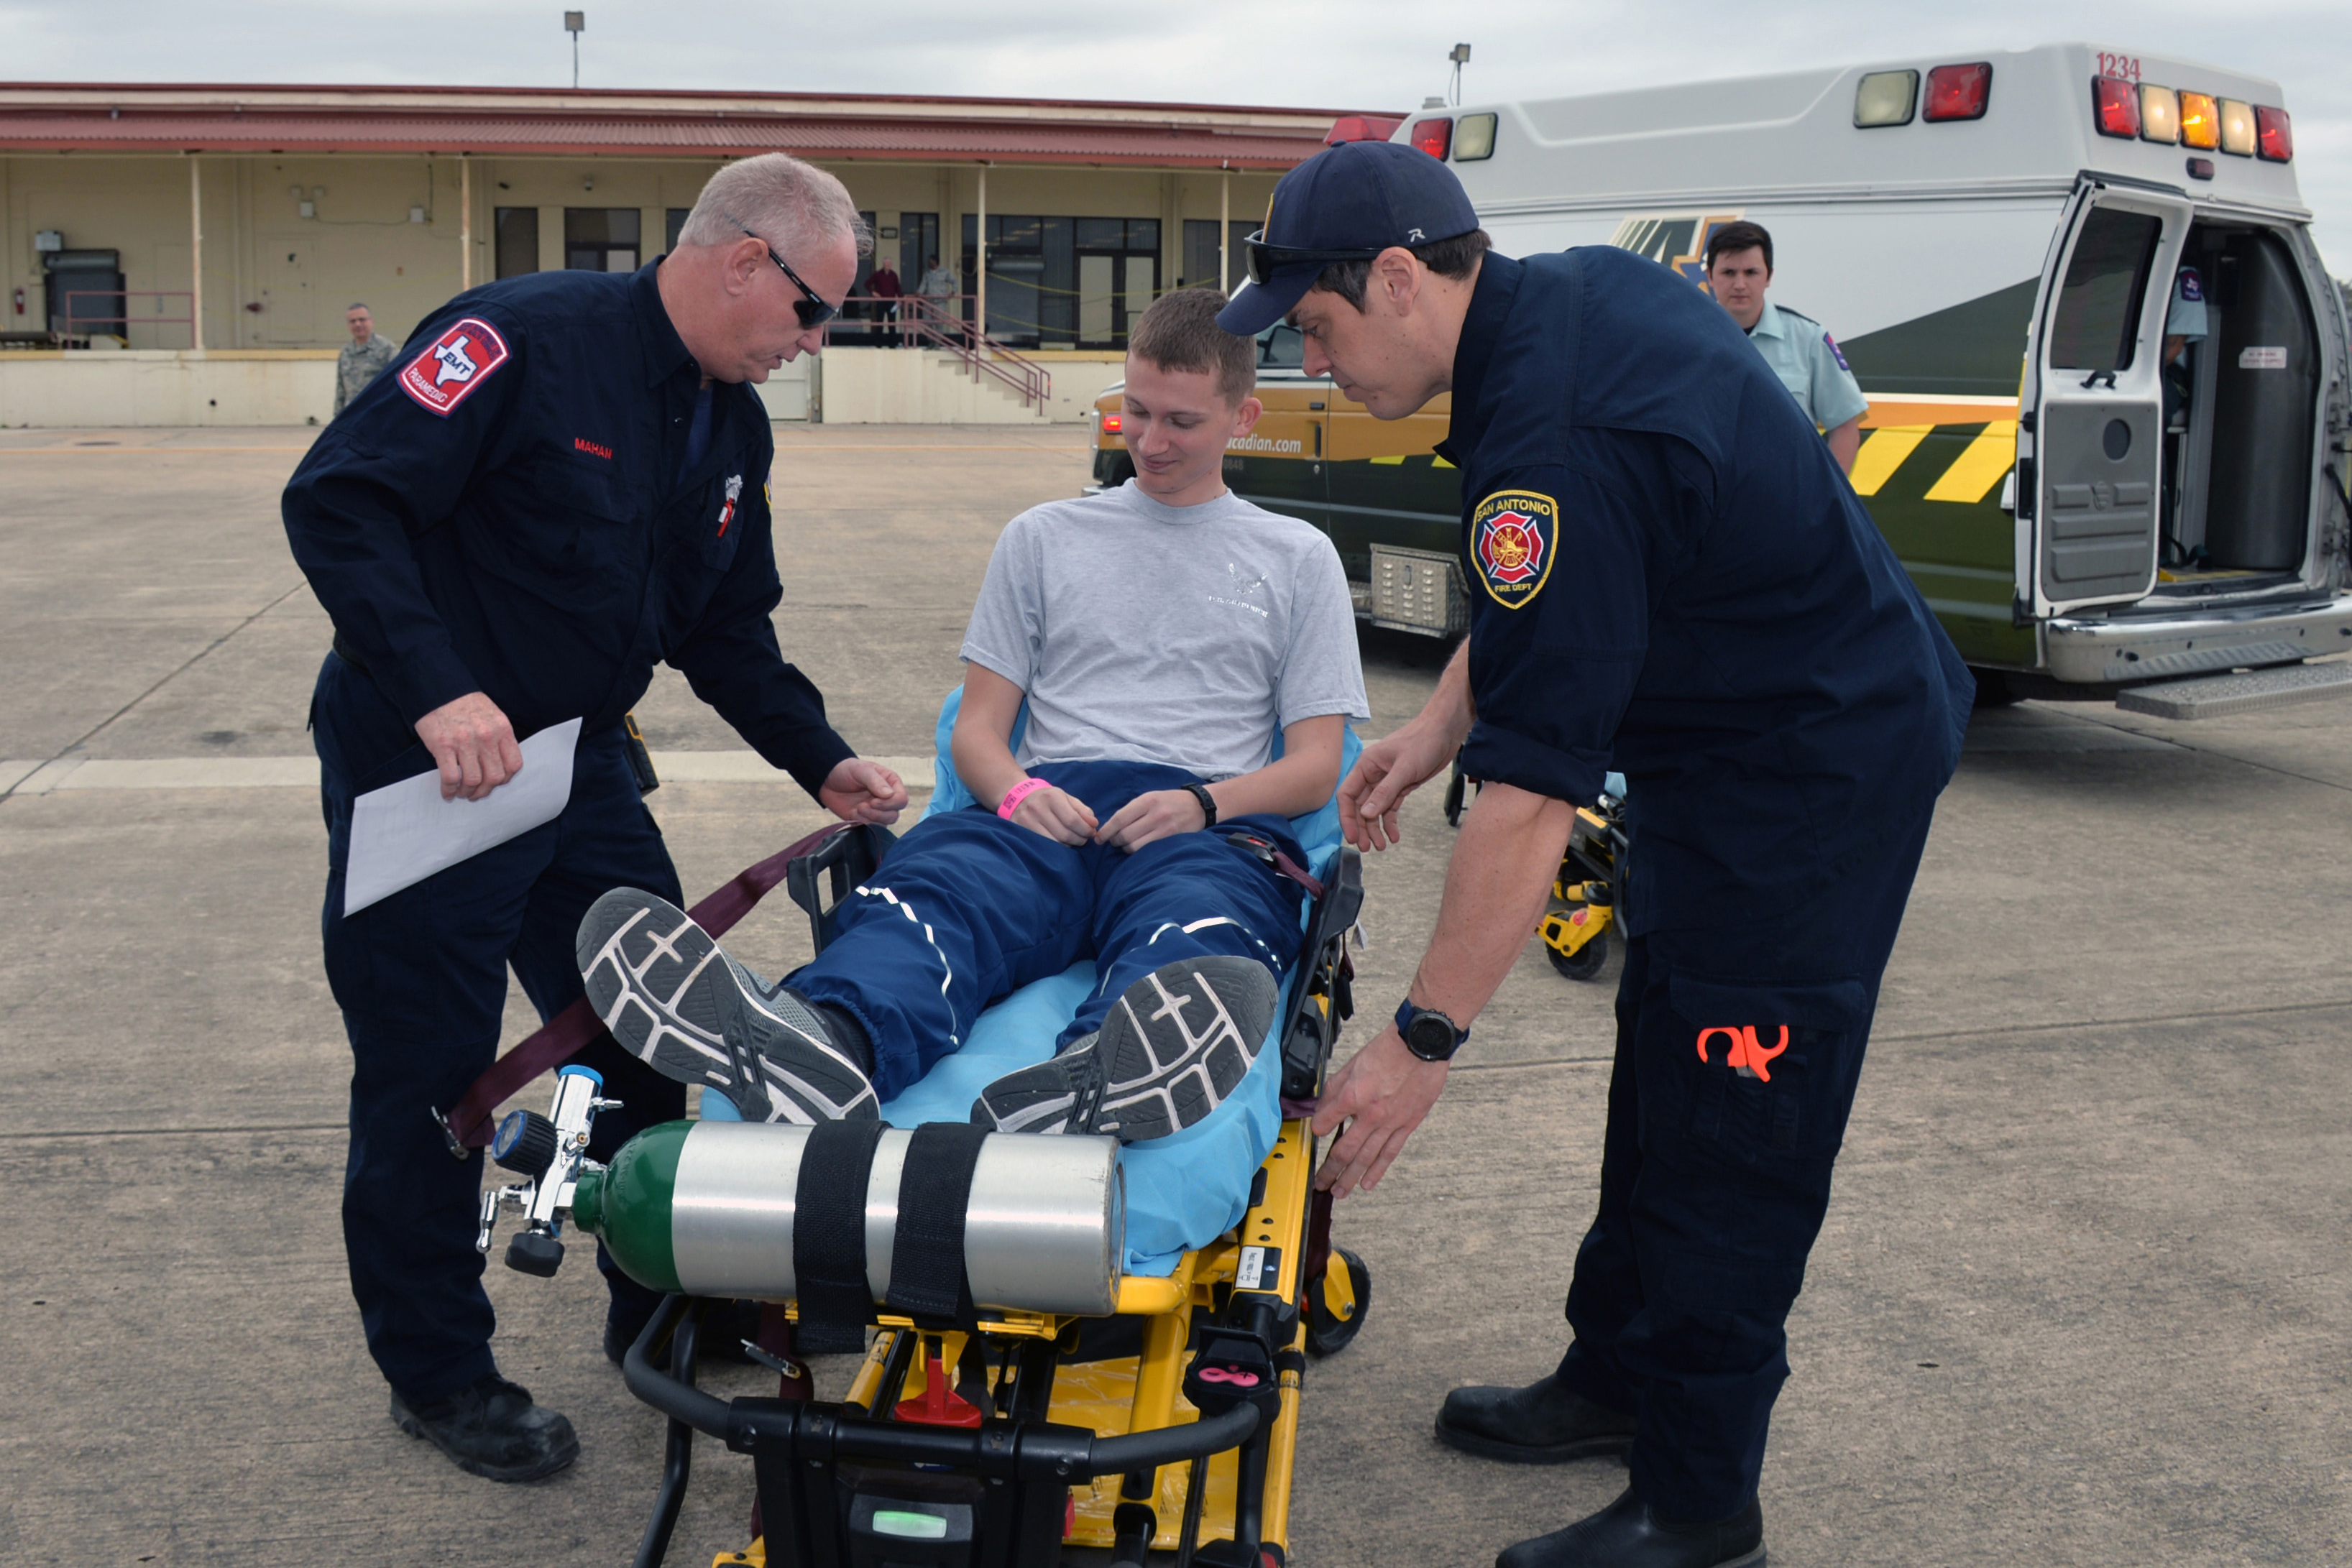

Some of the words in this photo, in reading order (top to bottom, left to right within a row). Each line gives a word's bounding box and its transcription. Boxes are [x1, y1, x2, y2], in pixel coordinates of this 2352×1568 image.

[2096, 52, 2141, 82] 1234
[443, 351, 472, 374] EMT
[408, 366, 449, 403] PARAMEDIC
[574, 437, 612, 460] MAHAN
[1477, 502, 1494, 522] SAN
[1495, 499, 1551, 516] ANTONIO
[1494, 584, 1512, 593] FIRE
[1512, 583, 1533, 591] DEPT
